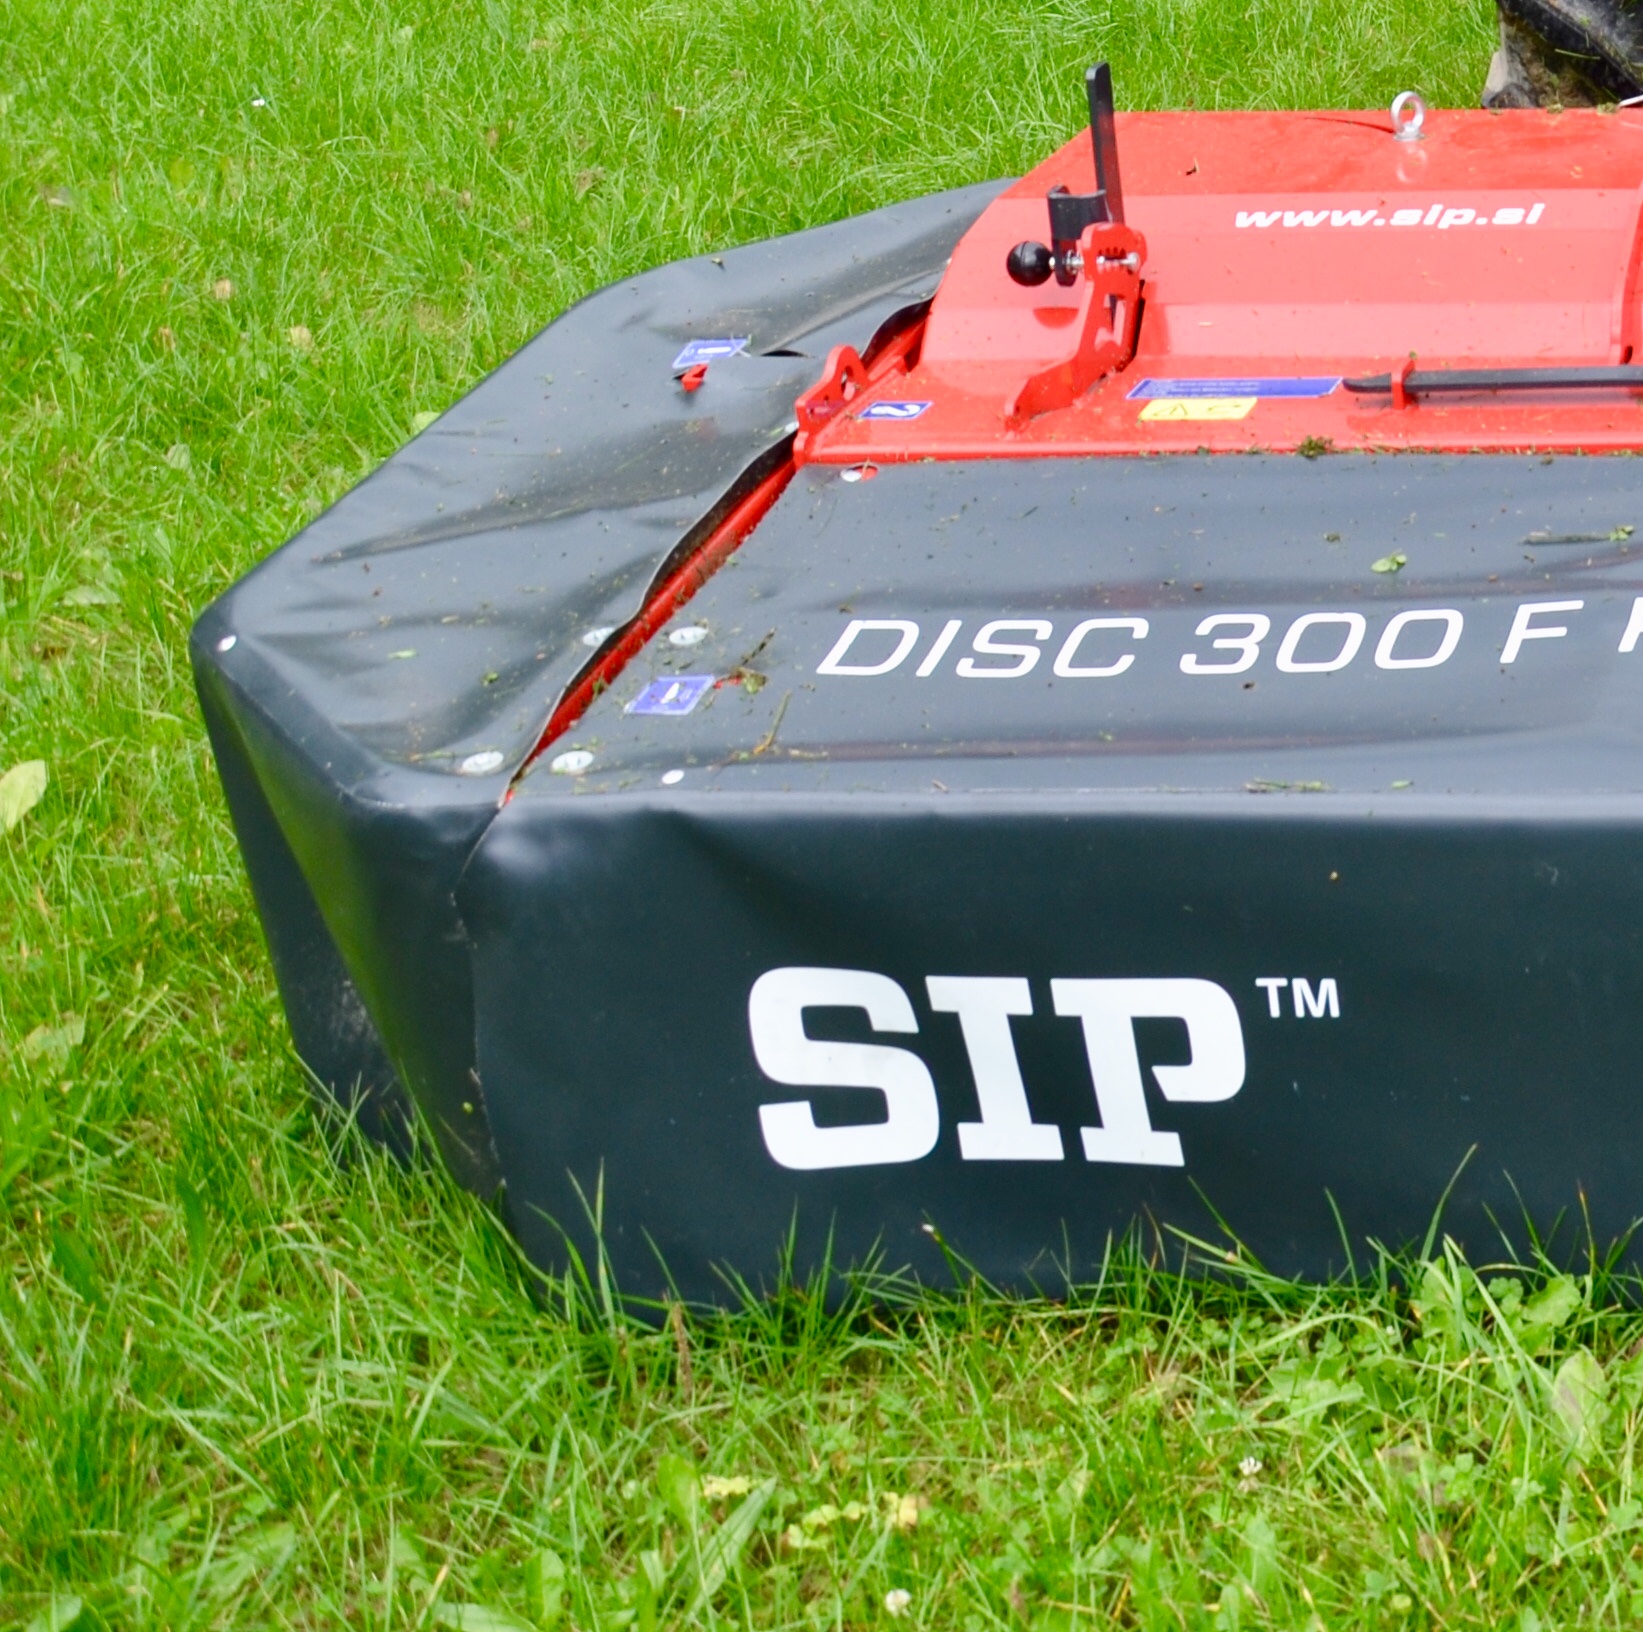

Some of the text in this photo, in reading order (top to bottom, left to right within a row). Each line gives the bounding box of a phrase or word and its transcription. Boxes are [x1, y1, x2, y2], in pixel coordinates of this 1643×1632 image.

[1235, 202, 1546, 230] www.sip.si
[816, 617, 1150, 678] DISC
[1180, 608, 1465, 675] 300
[1500, 599, 1585, 664] F
